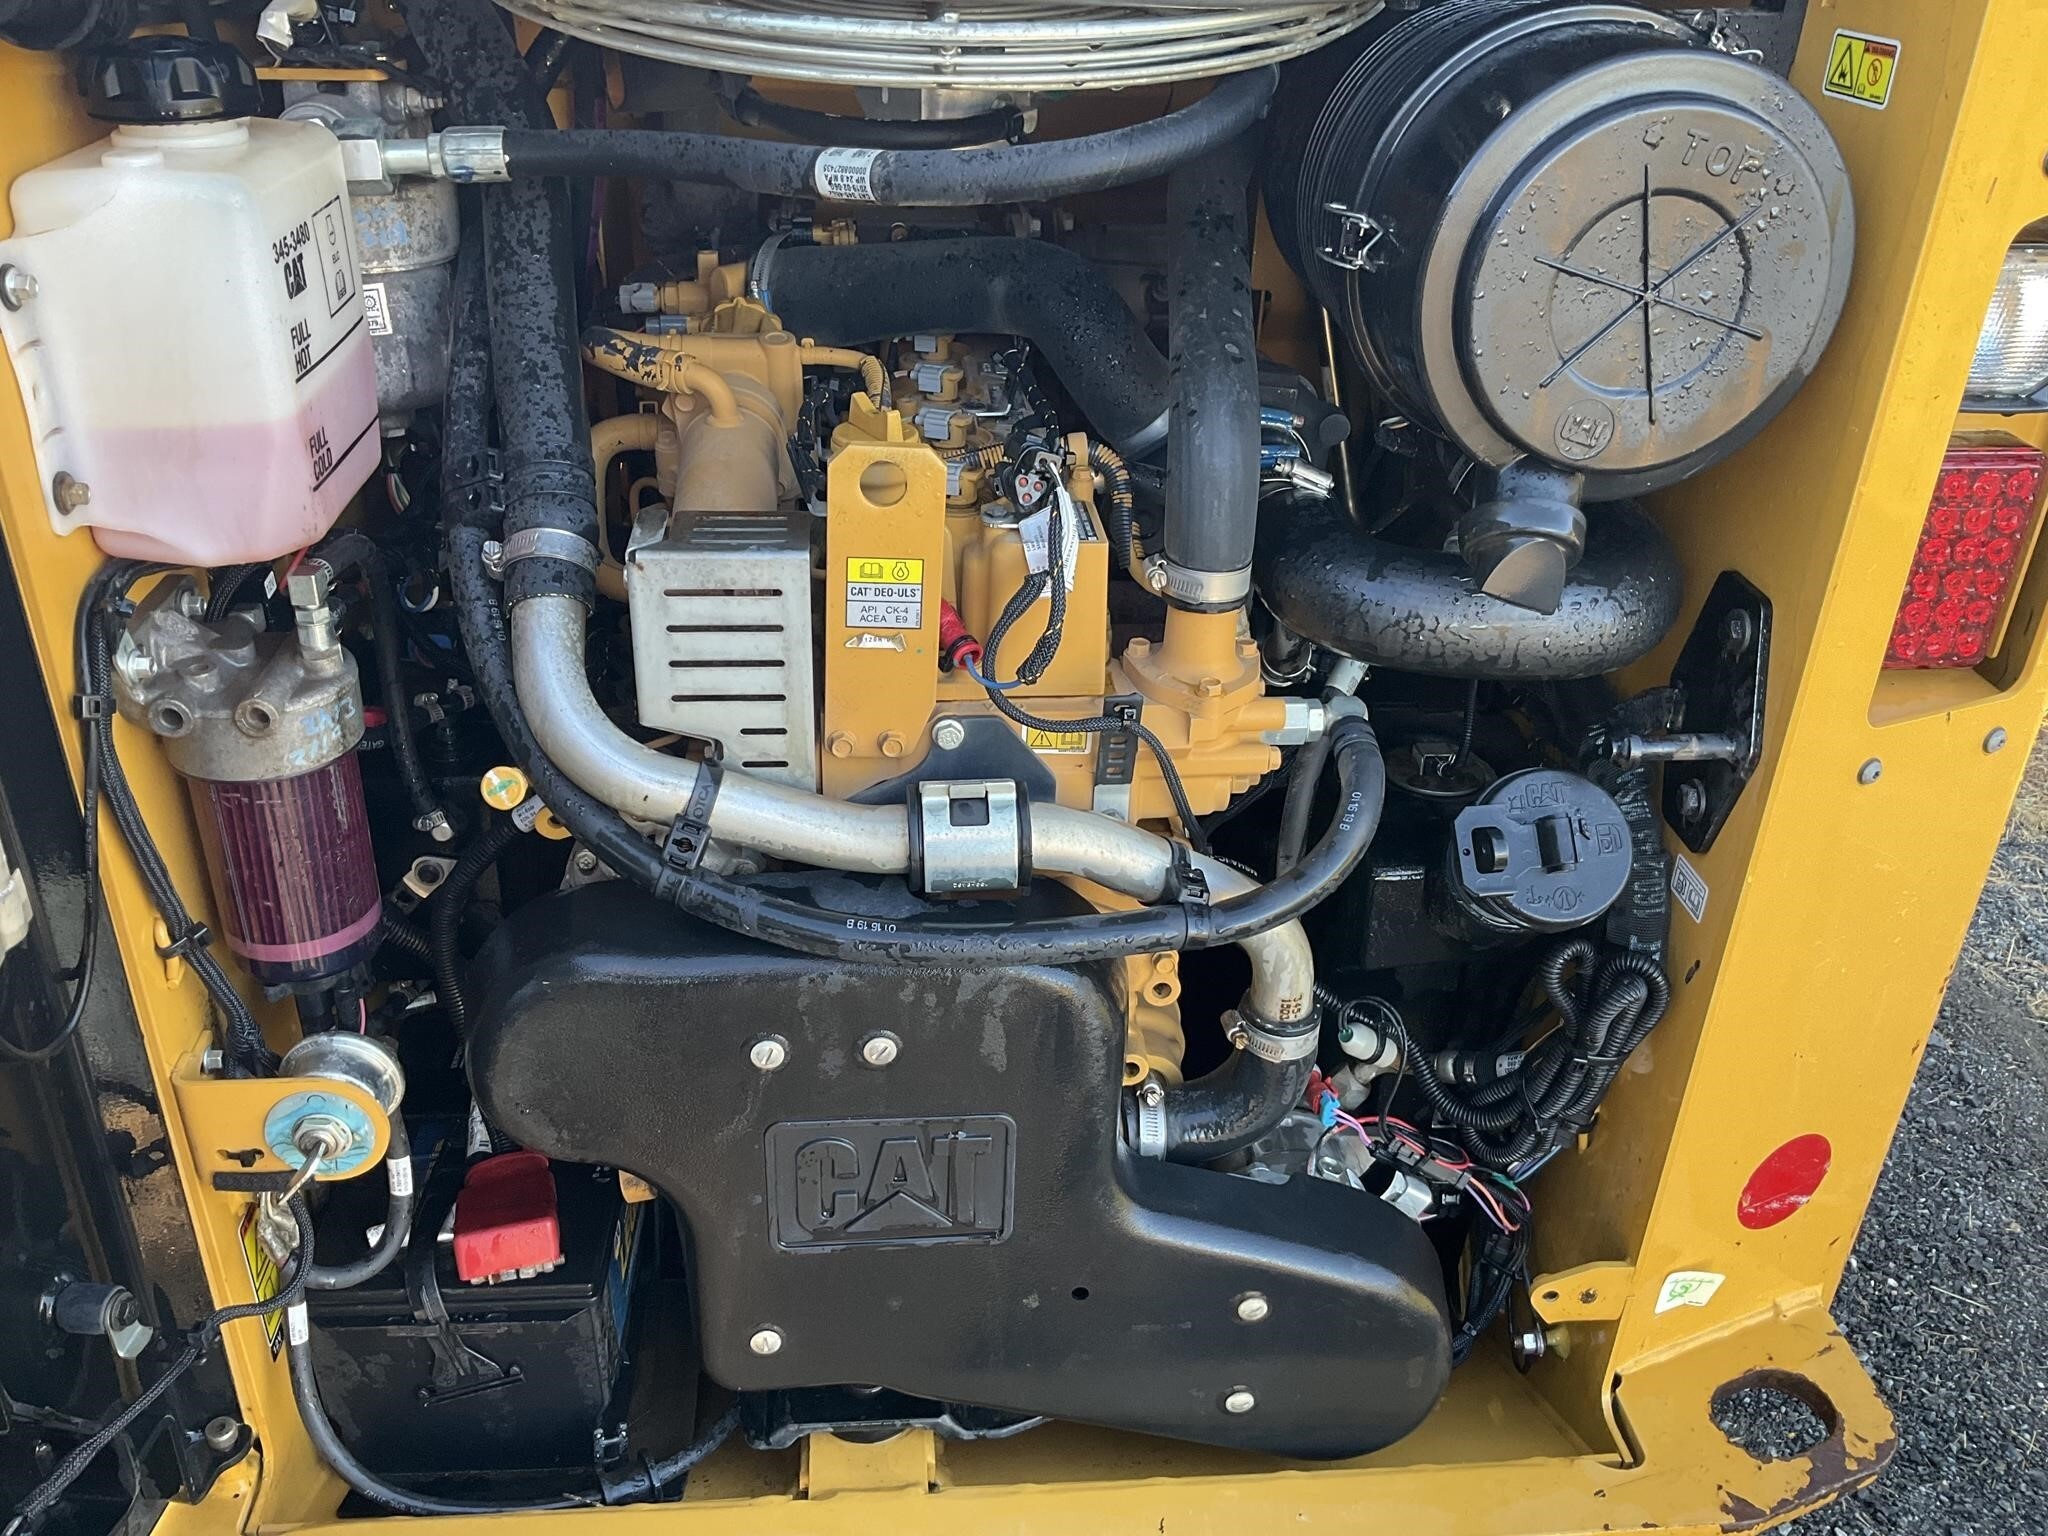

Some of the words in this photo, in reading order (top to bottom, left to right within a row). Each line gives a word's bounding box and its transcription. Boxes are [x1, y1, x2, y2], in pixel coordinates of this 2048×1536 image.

[1681, 128, 1766, 185] TOP
[272, 221, 311, 264] 345-3480
[283, 252, 308, 300] CAT
[290, 317, 312, 350] FULL
[294, 343, 312, 375] HOT
[309, 425, 329, 459] FULL
[313, 446, 333, 482] COLD
[859, 614, 888, 623] ACEA
[895, 615, 908, 624] E9
[860, 605, 877, 614] API
[885, 605, 909, 615] CK-4
[1347, 803, 1360, 812] 16
[1525, 781, 1567, 808] CAT
[857, 920, 868, 931] 19
[871, 922, 882, 933] 16
[795, 1133, 993, 1236] CAT
